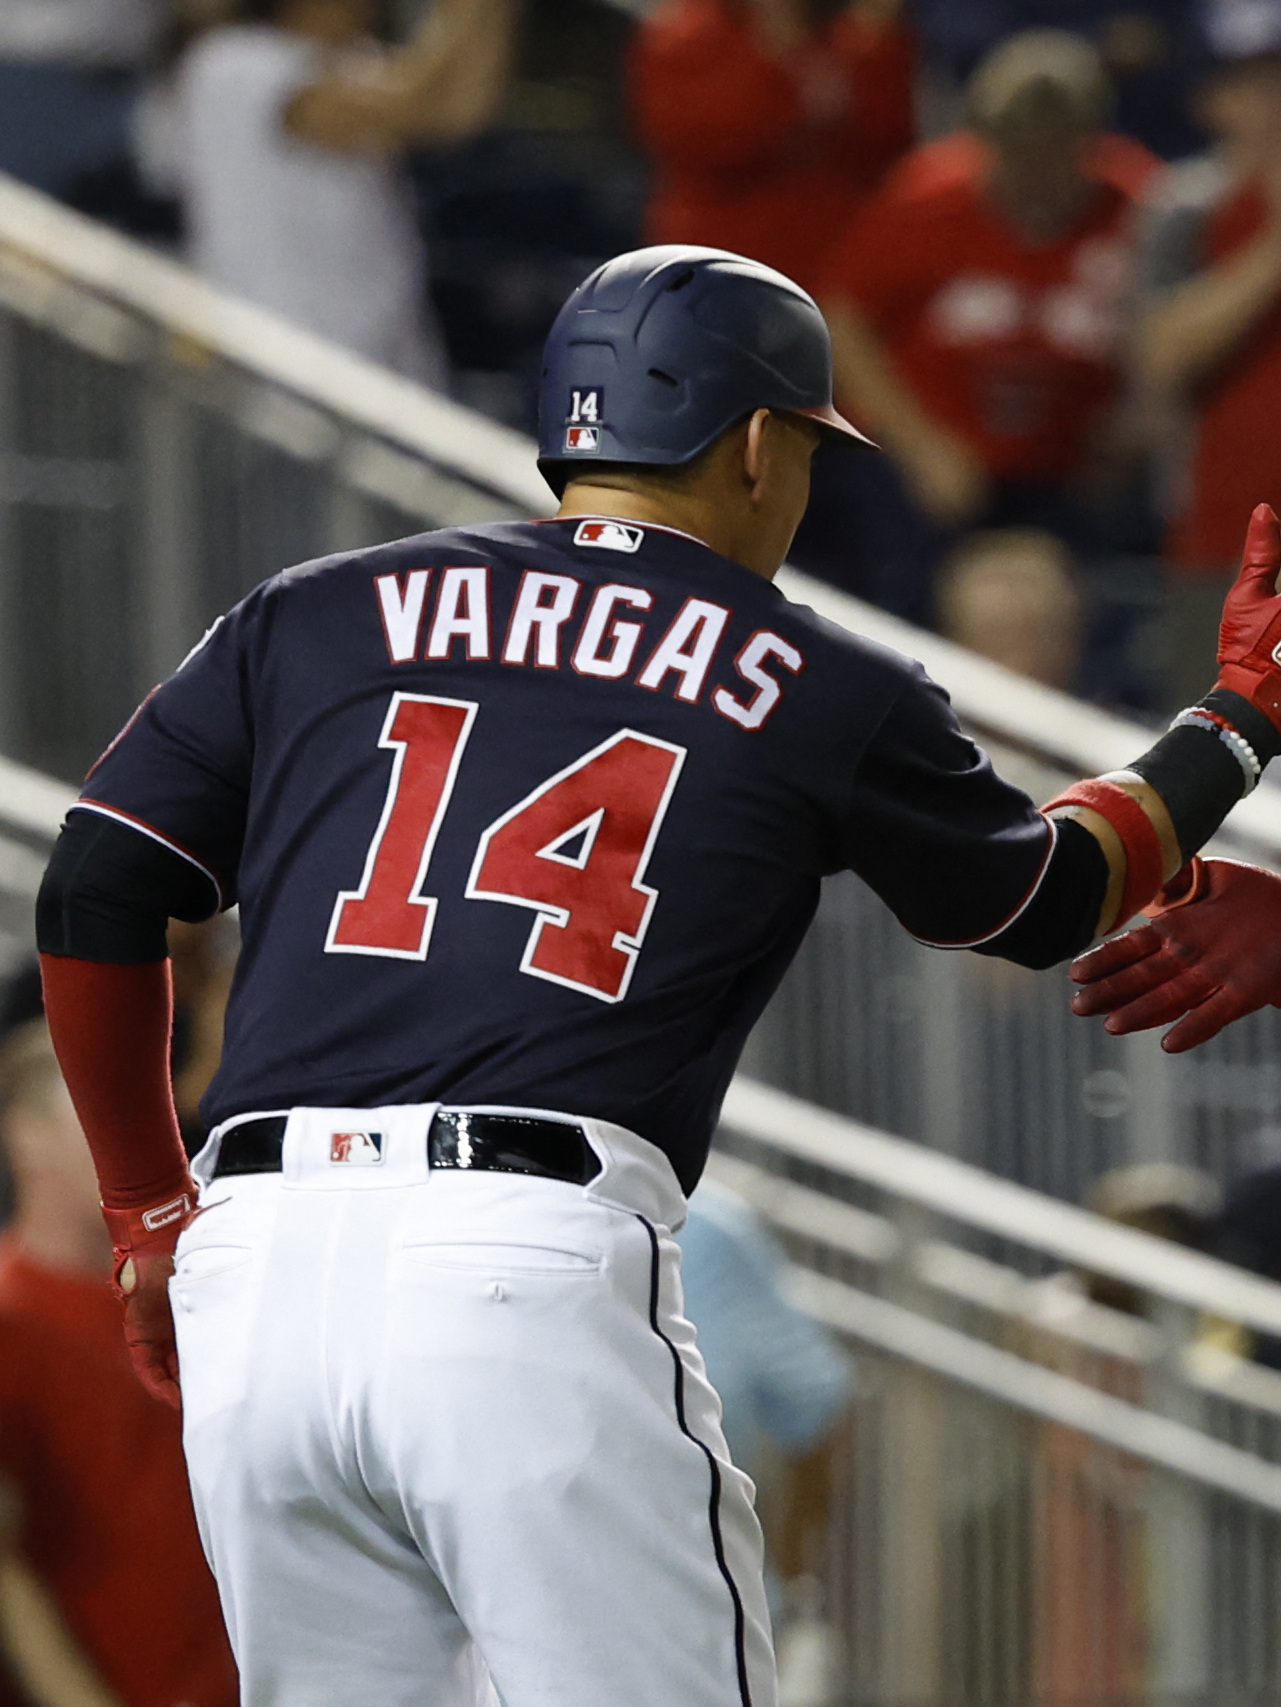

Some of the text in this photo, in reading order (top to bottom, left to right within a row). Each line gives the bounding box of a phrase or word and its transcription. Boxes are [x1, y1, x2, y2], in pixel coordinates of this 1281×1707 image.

[571, 391, 598, 422] 14
[374, 566, 805, 732] VARGAS
[324, 691, 687, 1004] 14
